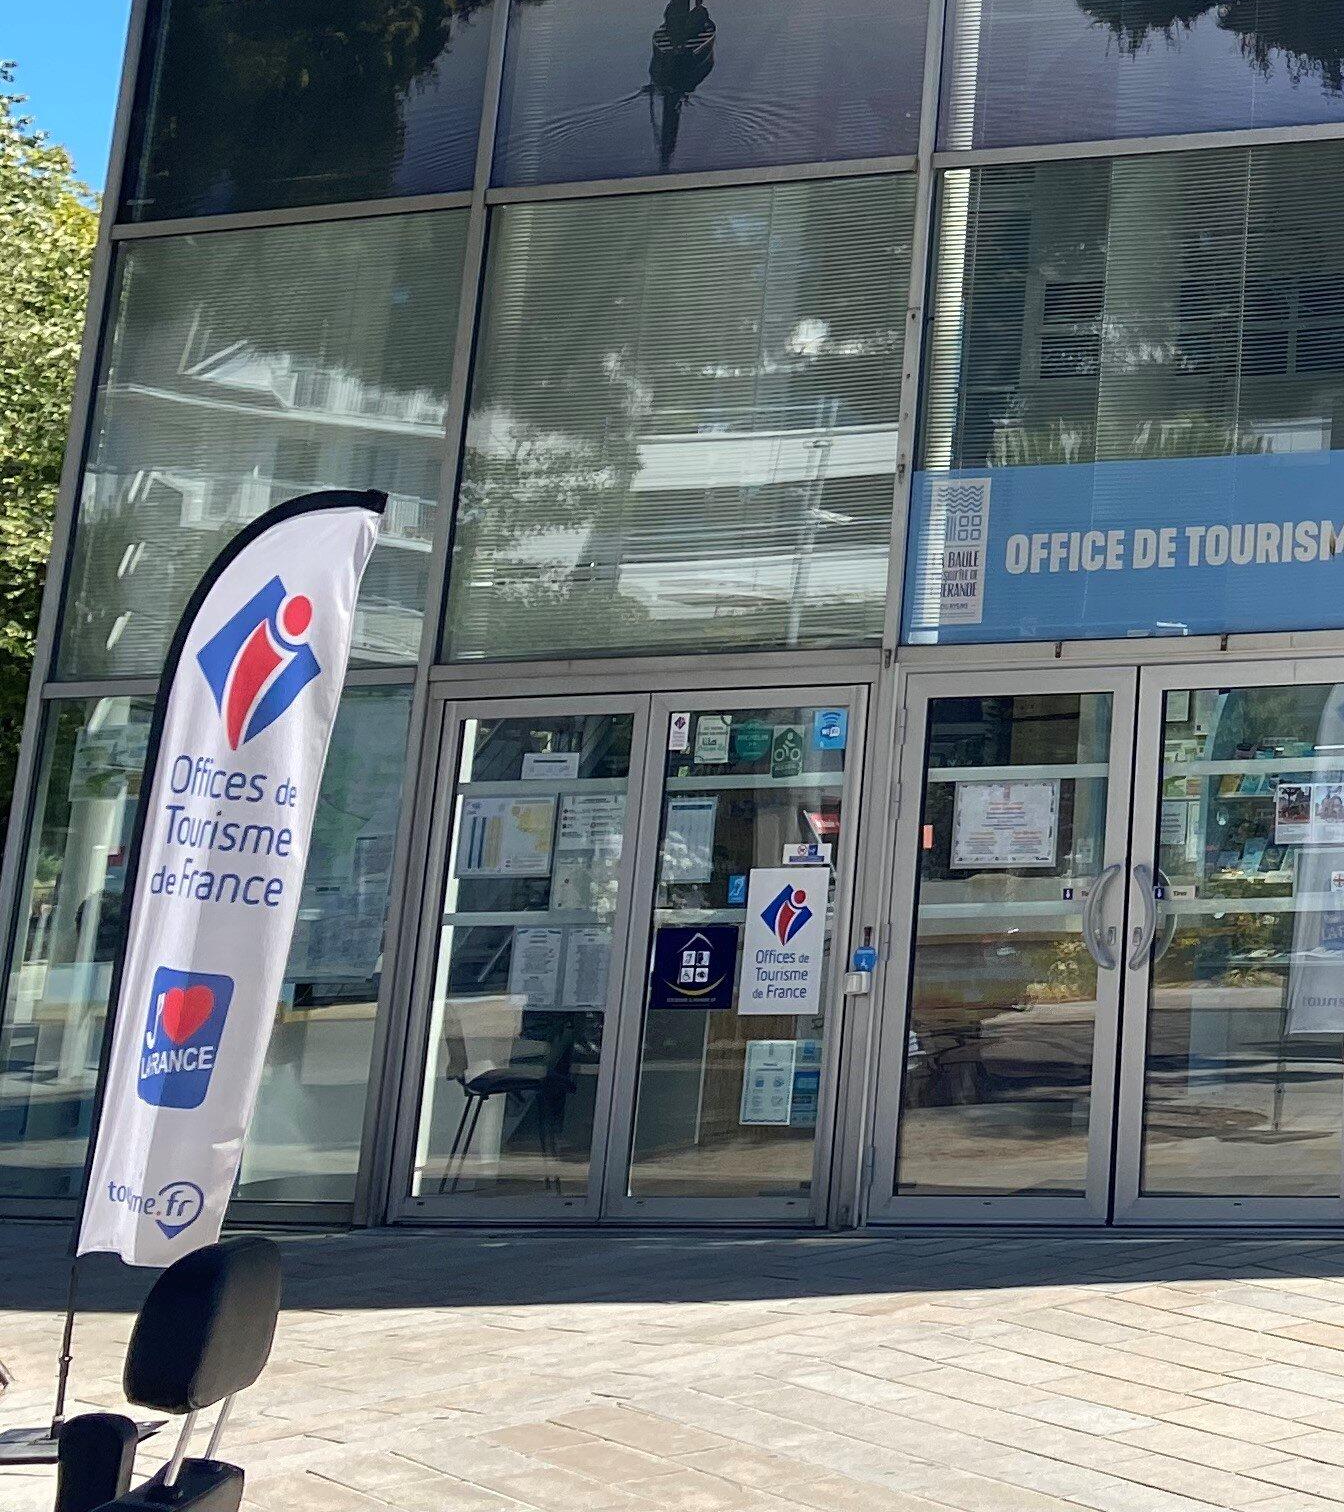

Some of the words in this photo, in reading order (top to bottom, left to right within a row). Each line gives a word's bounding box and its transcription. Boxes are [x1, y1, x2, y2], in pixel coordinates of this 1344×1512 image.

[949, 551, 979, 568] BAULE
[1005, 530, 1125, 574] OFFICE
[1132, 528, 1177, 569] DE
[171, 755, 268, 802] Offices
[275, 777, 297, 807] de
[166, 805, 292, 857] Tourisme
[151, 865, 177, 895] de
[178, 857, 284, 907] France
[755, 949, 796, 964] Offices
[798, 952, 810, 963] de
[755, 967, 808, 982] Tourisme
[752, 988, 764, 999] de
[766, 984, 807, 1000] France
